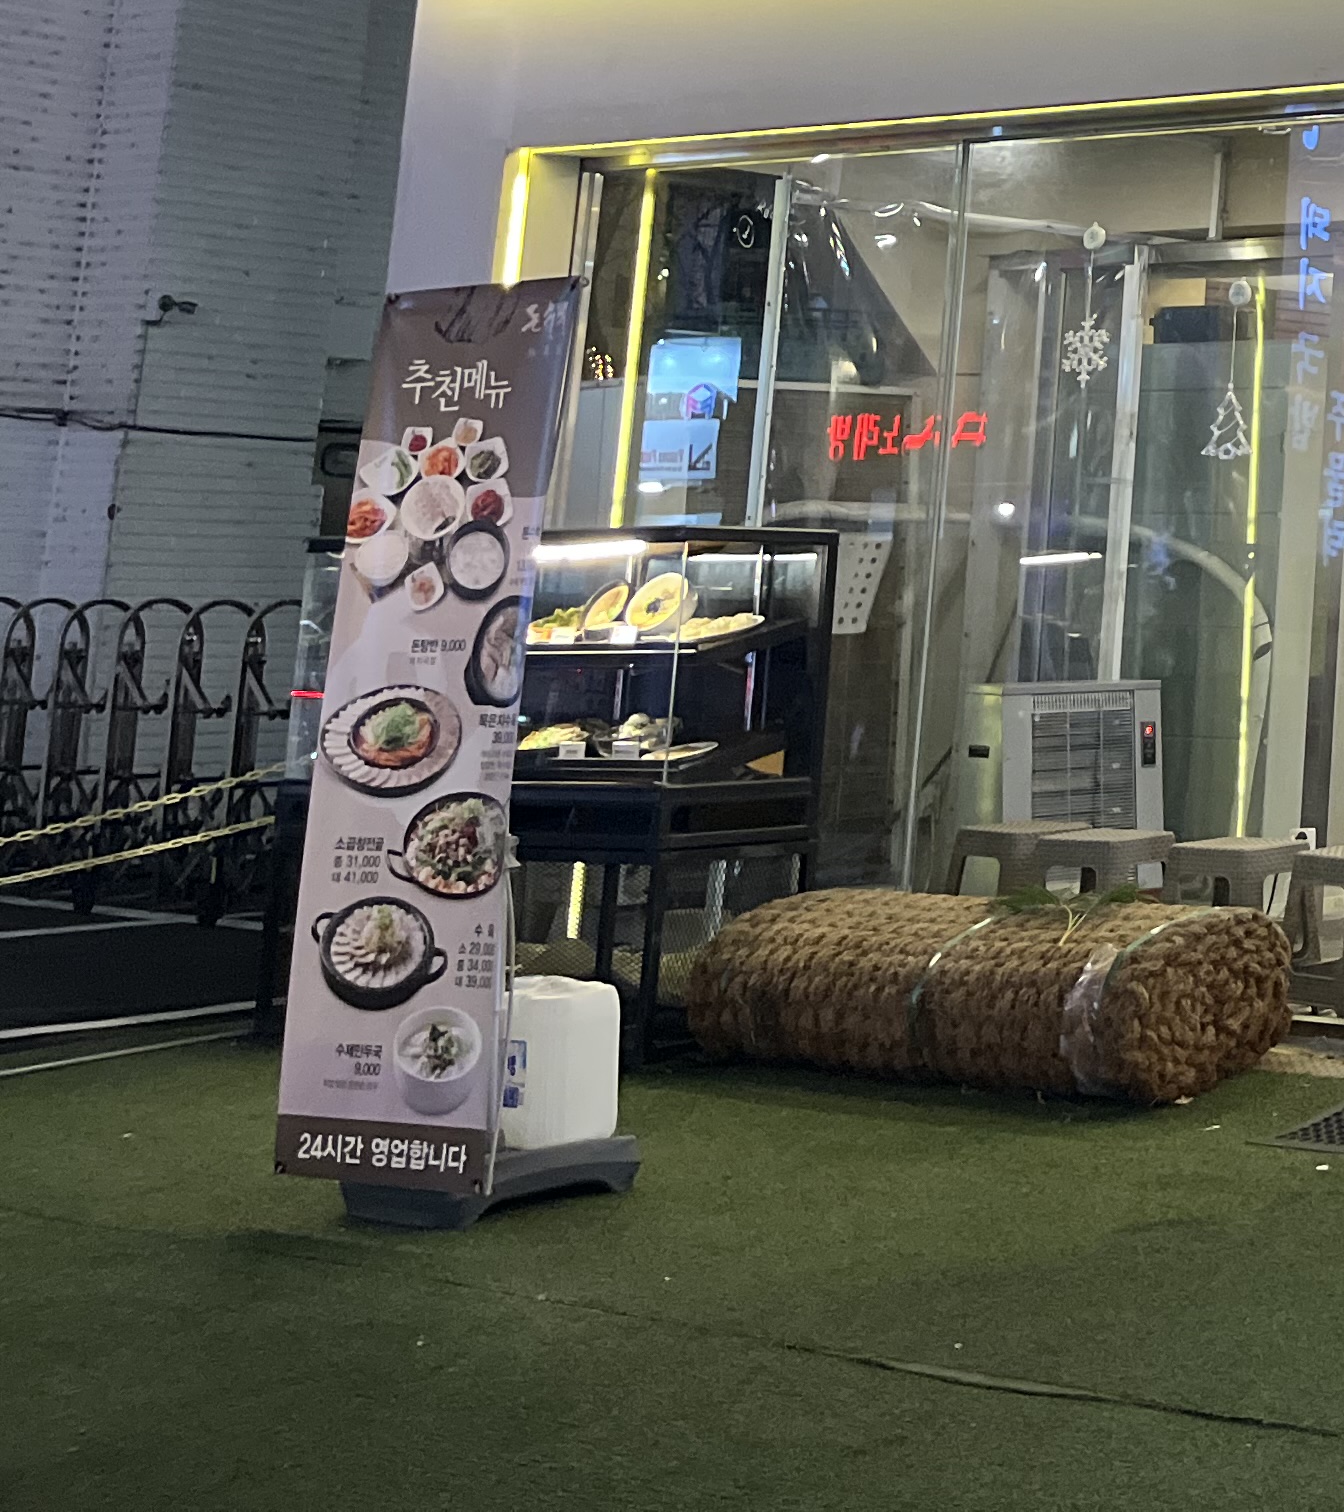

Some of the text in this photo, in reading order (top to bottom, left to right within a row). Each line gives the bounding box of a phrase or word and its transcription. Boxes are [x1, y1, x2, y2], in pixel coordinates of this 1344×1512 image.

[402, 359, 511, 413] 추천메뉴
[297, 1132, 467, 1174] 24시간 영업합니다
